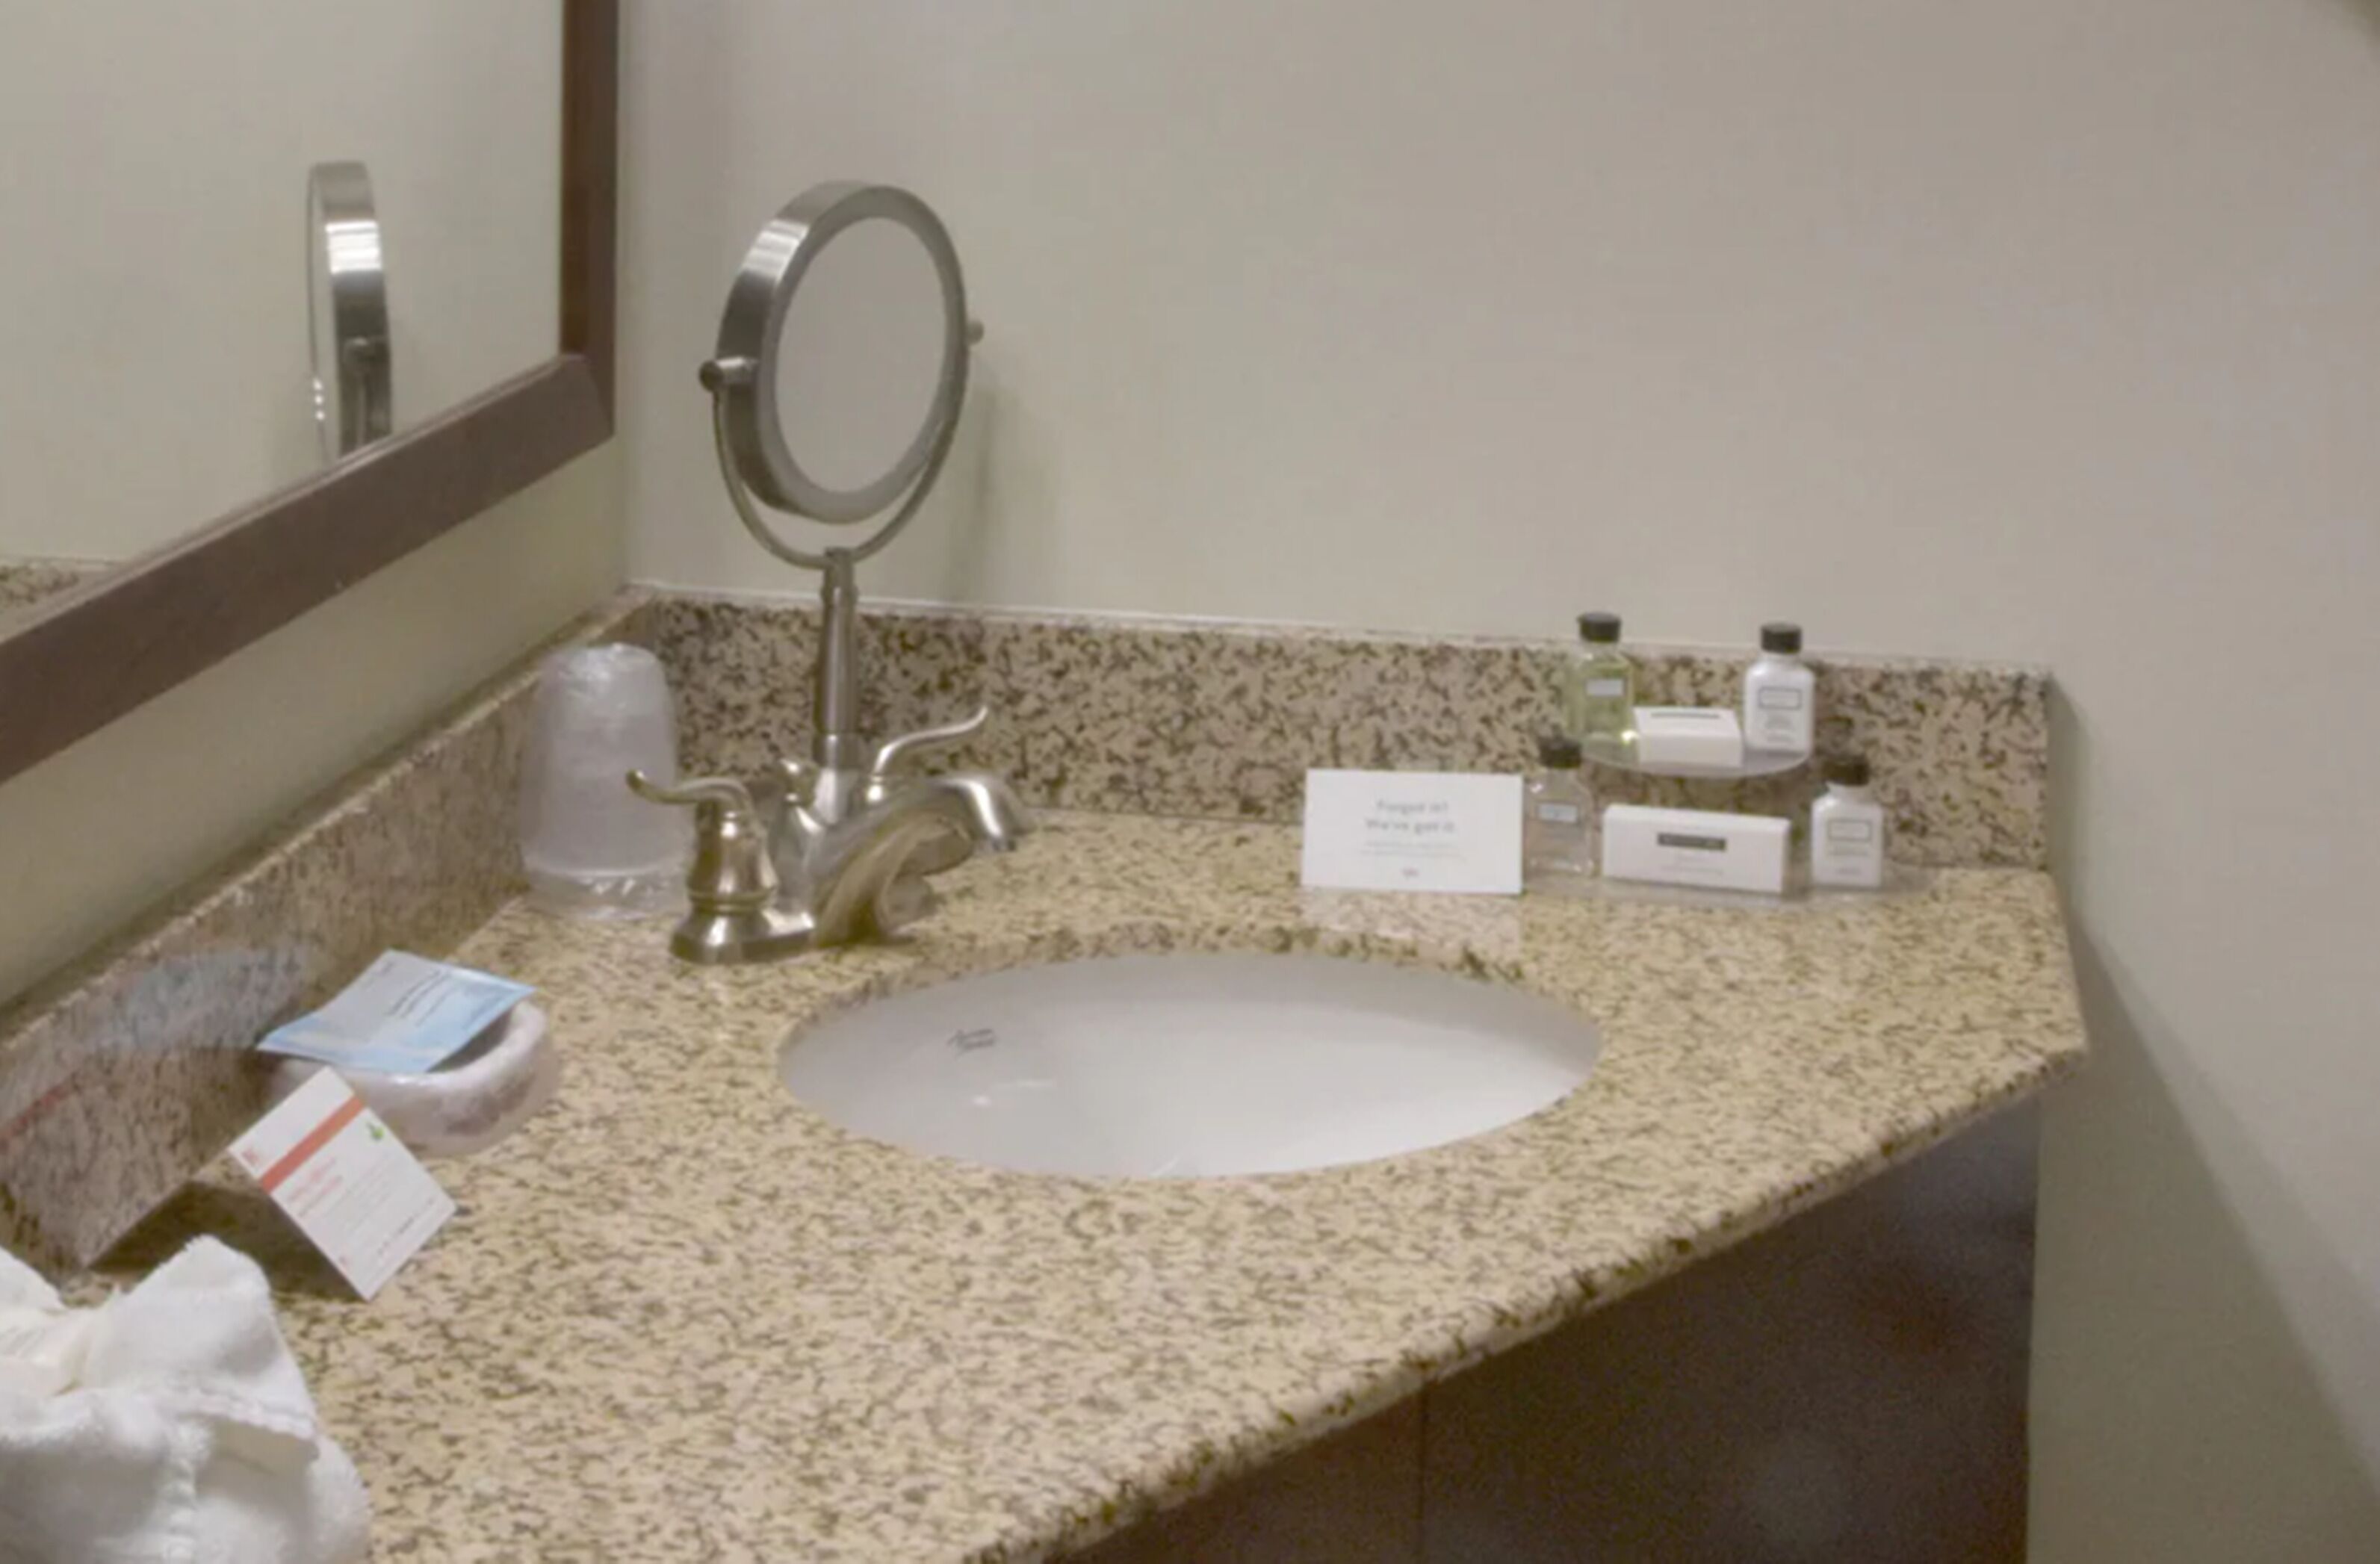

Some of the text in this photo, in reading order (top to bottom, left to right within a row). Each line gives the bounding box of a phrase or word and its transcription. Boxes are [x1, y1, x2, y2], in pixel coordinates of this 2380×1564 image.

[1377, 798, 1425, 816] Forgot
[1364, 817, 1409, 831] We've
[1413, 821, 1439, 836] got
